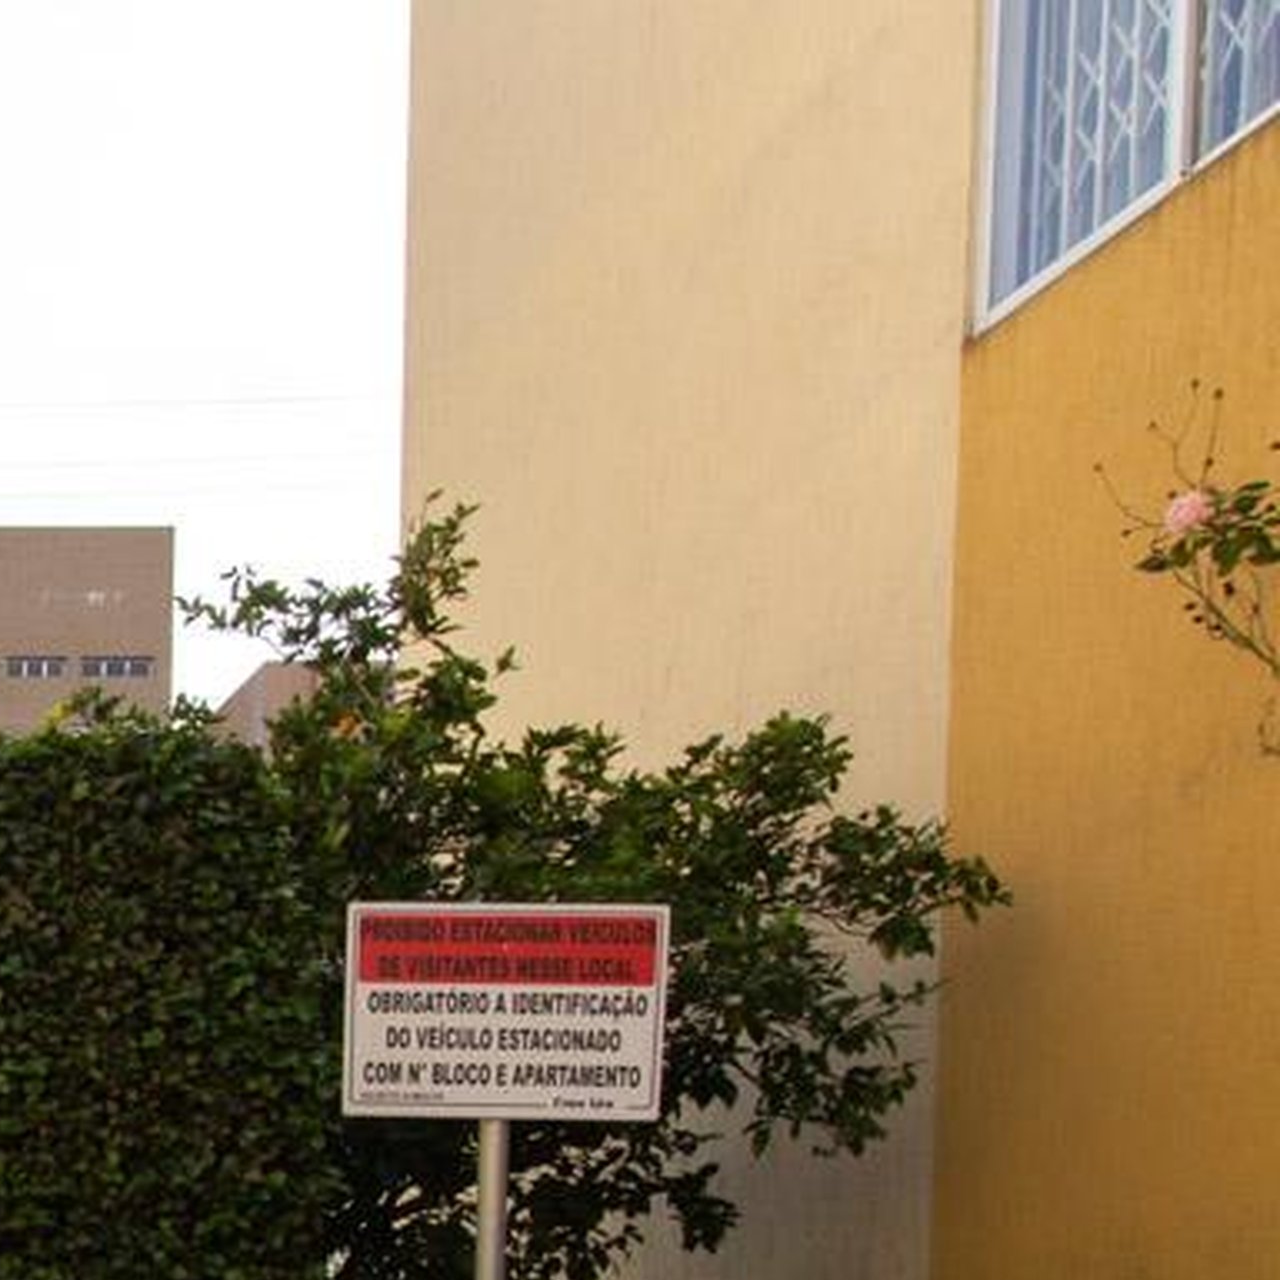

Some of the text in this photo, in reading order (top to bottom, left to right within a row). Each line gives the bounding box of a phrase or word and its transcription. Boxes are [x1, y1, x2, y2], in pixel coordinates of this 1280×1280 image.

[377, 954, 400, 978] DE
[406, 955, 510, 979] VISITANTES
[579, 958, 636, 981] LOCAL
[367, 988, 649, 1019] OBRIGATÓRIO A IDENTIFICAÇÃO
[386, 1022, 622, 1052] DO VEÍCULO ESTACIONADO
[362, 1061, 402, 1085] COM
[432, 1062, 490, 1086] BLOCO
[495, 1063, 507, 1086] E
[512, 1064, 642, 1089] APARTAMENTO
